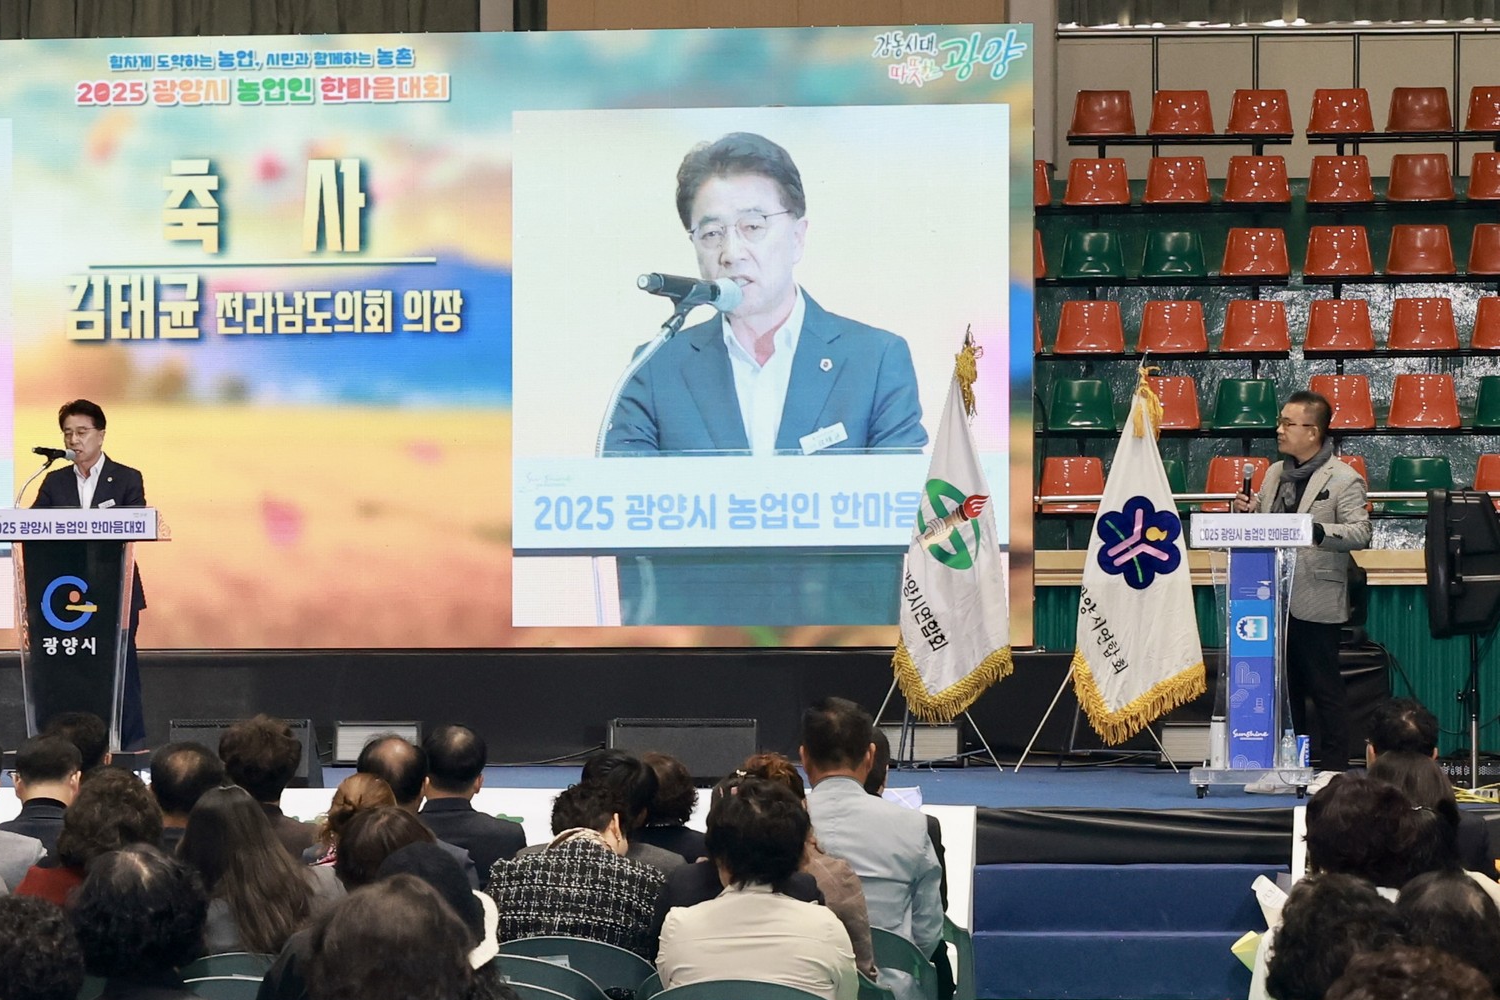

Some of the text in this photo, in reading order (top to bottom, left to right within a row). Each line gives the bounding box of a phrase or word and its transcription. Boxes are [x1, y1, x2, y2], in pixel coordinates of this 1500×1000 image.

[109, 47, 413, 69] 힘차게 도약하는 농업, 시민과 함께하는 농촌
[940, 31, 1026, 80] 광양
[76, 75, 448, 104] 2025 광양시 농업인 한마음대회
[163, 159, 366, 253] 축 사
[65, 273, 463, 340] 김태균 전라남도의회 의장
[534, 495, 615, 531] 2025
[625, 493, 716, 530] 광양시
[727, 492, 820, 528] 농업인
[19, 521, 52, 535] 광양시
[55, 521, 88, 534] 농업인
[91, 520, 146, 534] 한마음대회
[1221, 528, 1242, 541] 광양시
[1244, 528, 1266, 541] 농업인
[42, 636, 97, 656] 광양시
